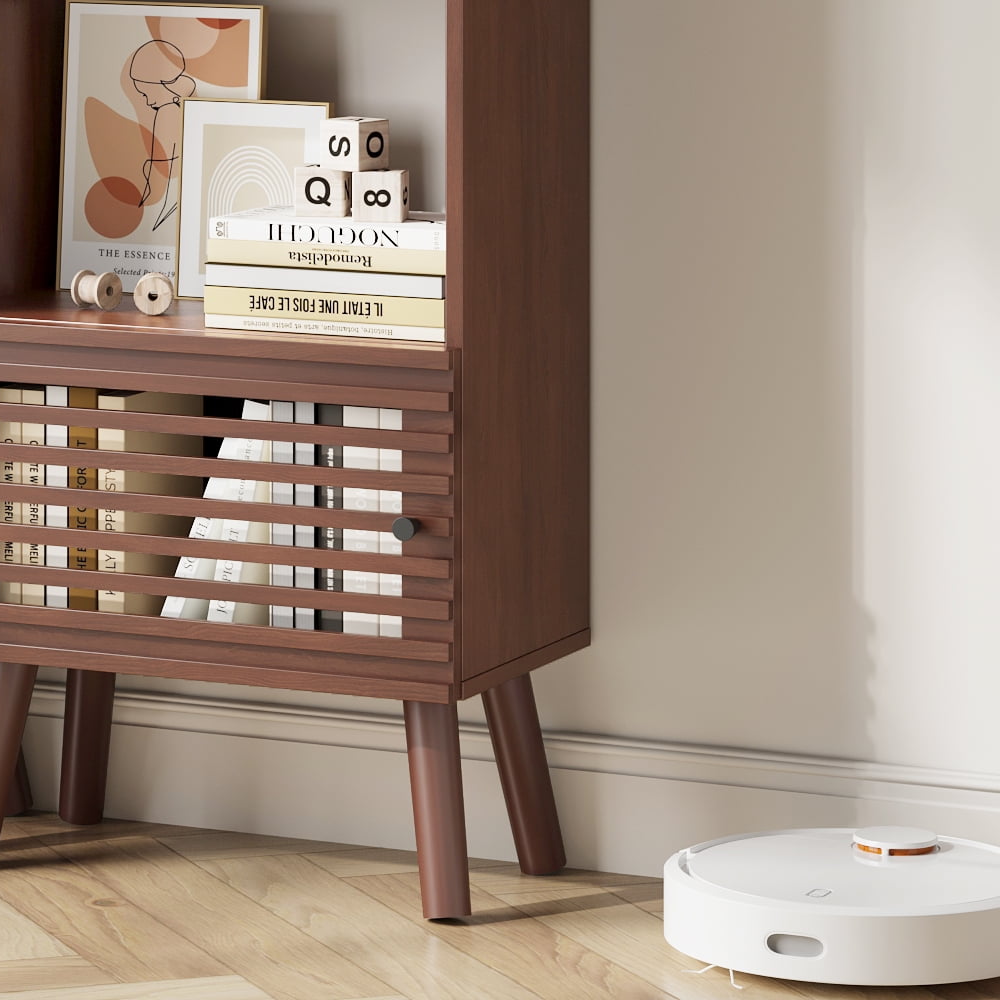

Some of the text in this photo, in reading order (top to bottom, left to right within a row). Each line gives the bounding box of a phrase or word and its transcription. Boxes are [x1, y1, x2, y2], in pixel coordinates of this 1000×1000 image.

[304, 176, 331, 207] Q
[268, 222, 401, 248] NOGUCHI
[98, 248, 171, 261] THE ESSENCE
[288, 250, 374, 268] Remodelista
[248, 295, 383, 319] IL ÉTAIT UNE FOIS LE CAFÉ
[271, 320, 293, 329] petits
[303, 323, 319, 331] arts
[321, 323, 360, 335] botanique,
[362, 326, 393, 337] Histoire,
